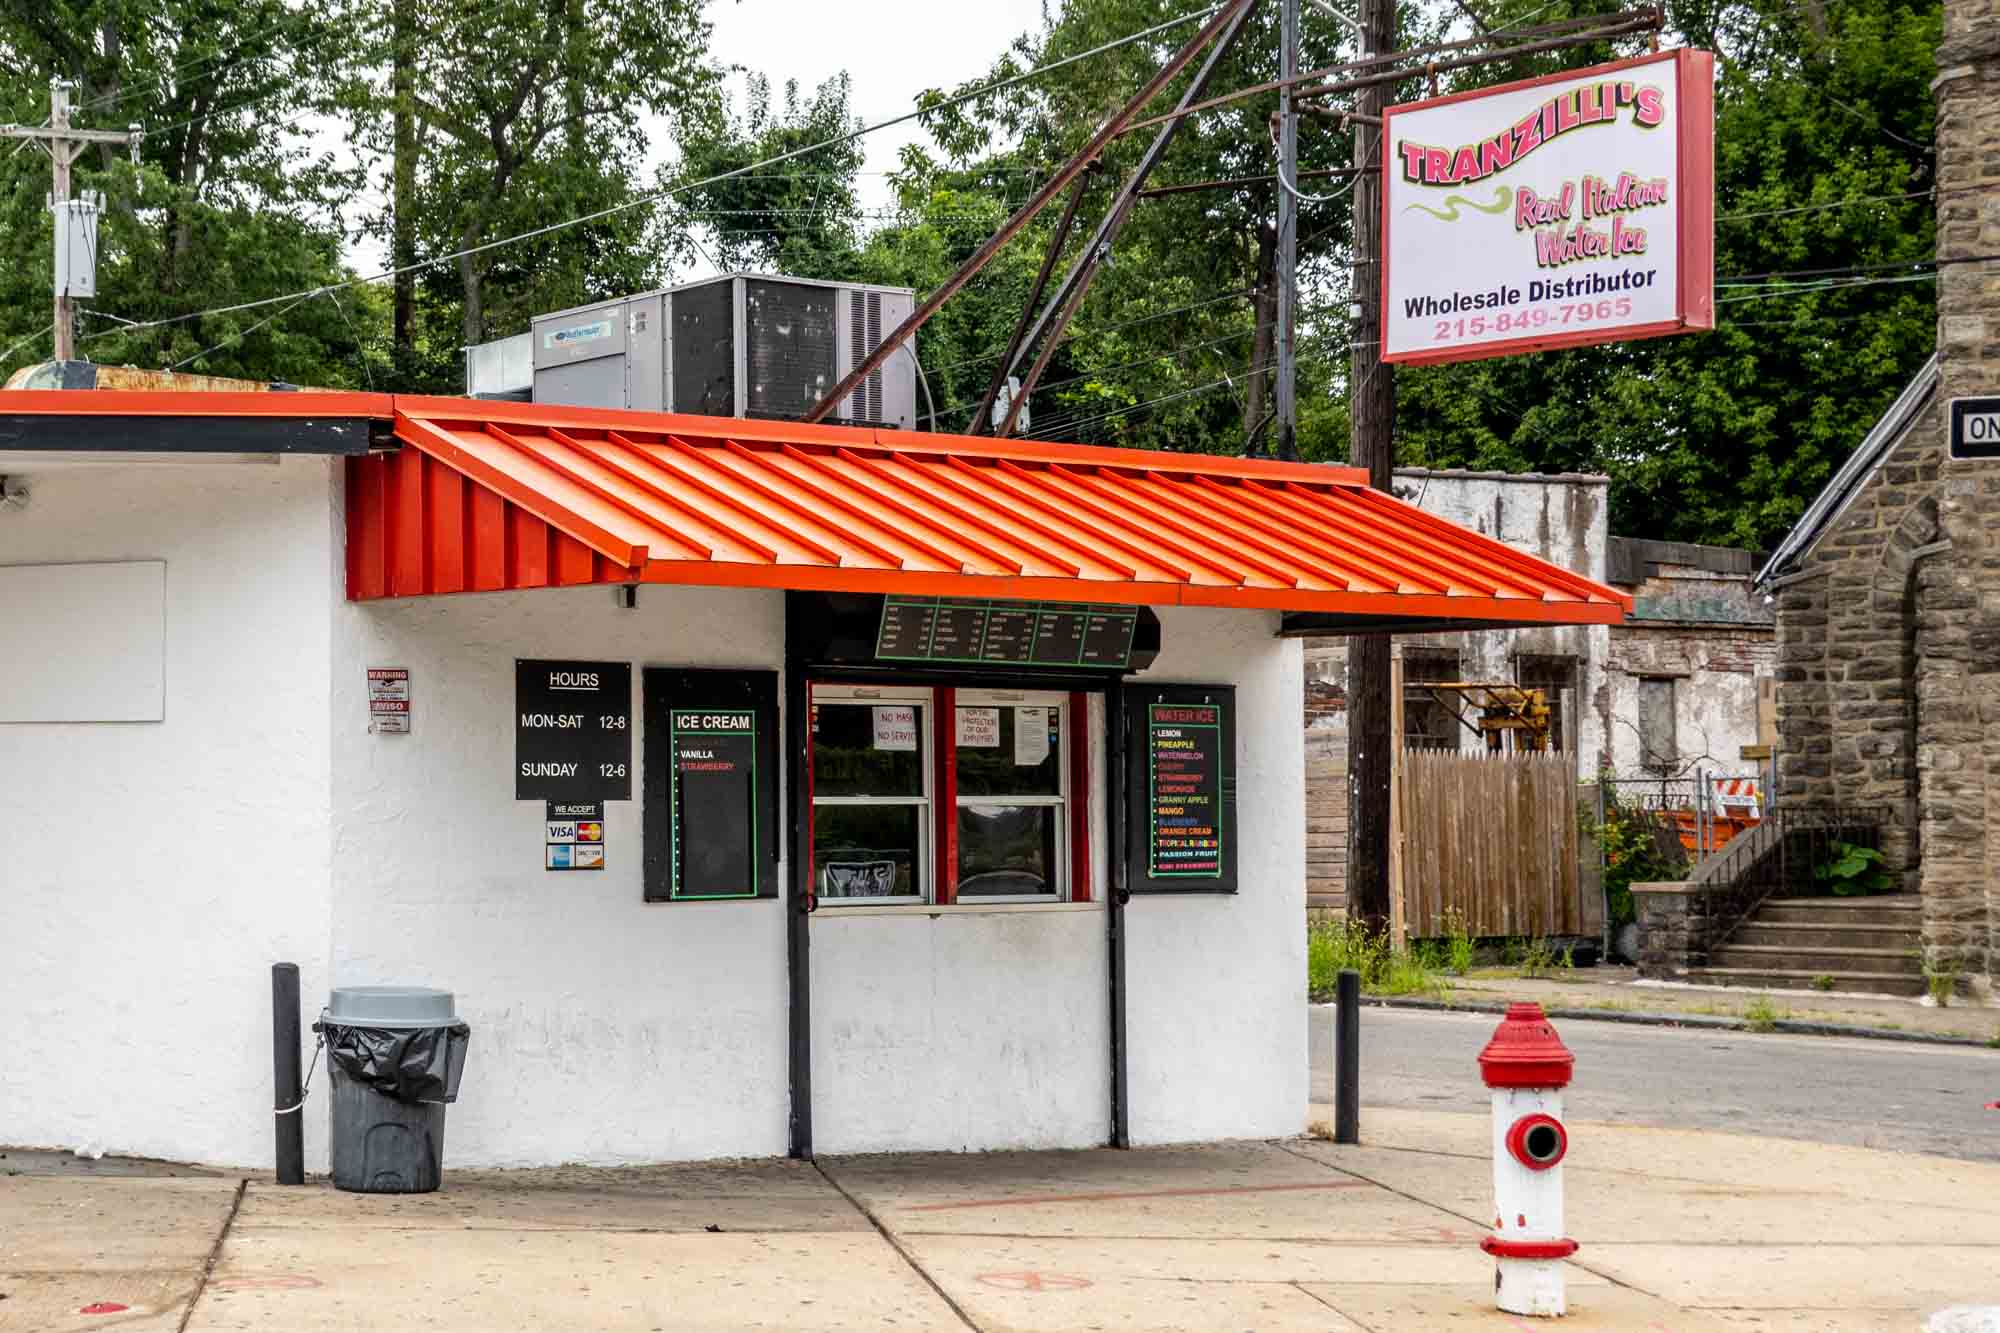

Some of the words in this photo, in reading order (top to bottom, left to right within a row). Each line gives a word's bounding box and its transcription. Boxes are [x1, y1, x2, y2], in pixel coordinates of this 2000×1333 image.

[1400, 82, 1664, 185] TRANZILLI'S
[1515, 181, 1574, 230] Real
[1581, 174, 1666, 219] Italian
[1536, 223, 1608, 267] Water
[1612, 215, 1648, 258] Ice
[1404, 285, 1521, 318] Wholesale
[1529, 268, 1656, 303] Distributor
[1434, 297, 1633, 340] 215-849-7965
[368, 671, 407, 680] WARNING
[549, 671, 600, 687] HOURS
[521, 713, 584, 728] MON-SAT
[599, 715, 626, 728] 12-8
[881, 712, 893, 721] NO
[1154, 709, 1194, 721] WATER
[1196, 710, 1216, 722] ICE
[677, 715, 700, 729] ICE
[702, 715, 750, 729] CREAM
[878, 731, 890, 741] NO
[1157, 729, 1182, 737] LEMON
[1157, 740, 1195, 749] PINEAPPLE
[680, 750, 714, 759] VANILLA
[1158, 751, 1204, 760] WATERMELON
[521, 762, 578, 777] SUNDAY
[599, 763, 626, 777] 12-6
[1158, 795, 1186, 804] GRANNY
[1187, 795, 1209, 804] APPLE
[554, 805, 567, 813] WE
[567, 805, 595, 813] ACCEPT
[1158, 807, 1184, 815] MANGO
[550, 826, 575, 838] VISA
[1159, 827, 1187, 835] ORANGE
[1188, 827, 1212, 835] CREAM
[1159, 839, 1189, 848] TROPICAL
